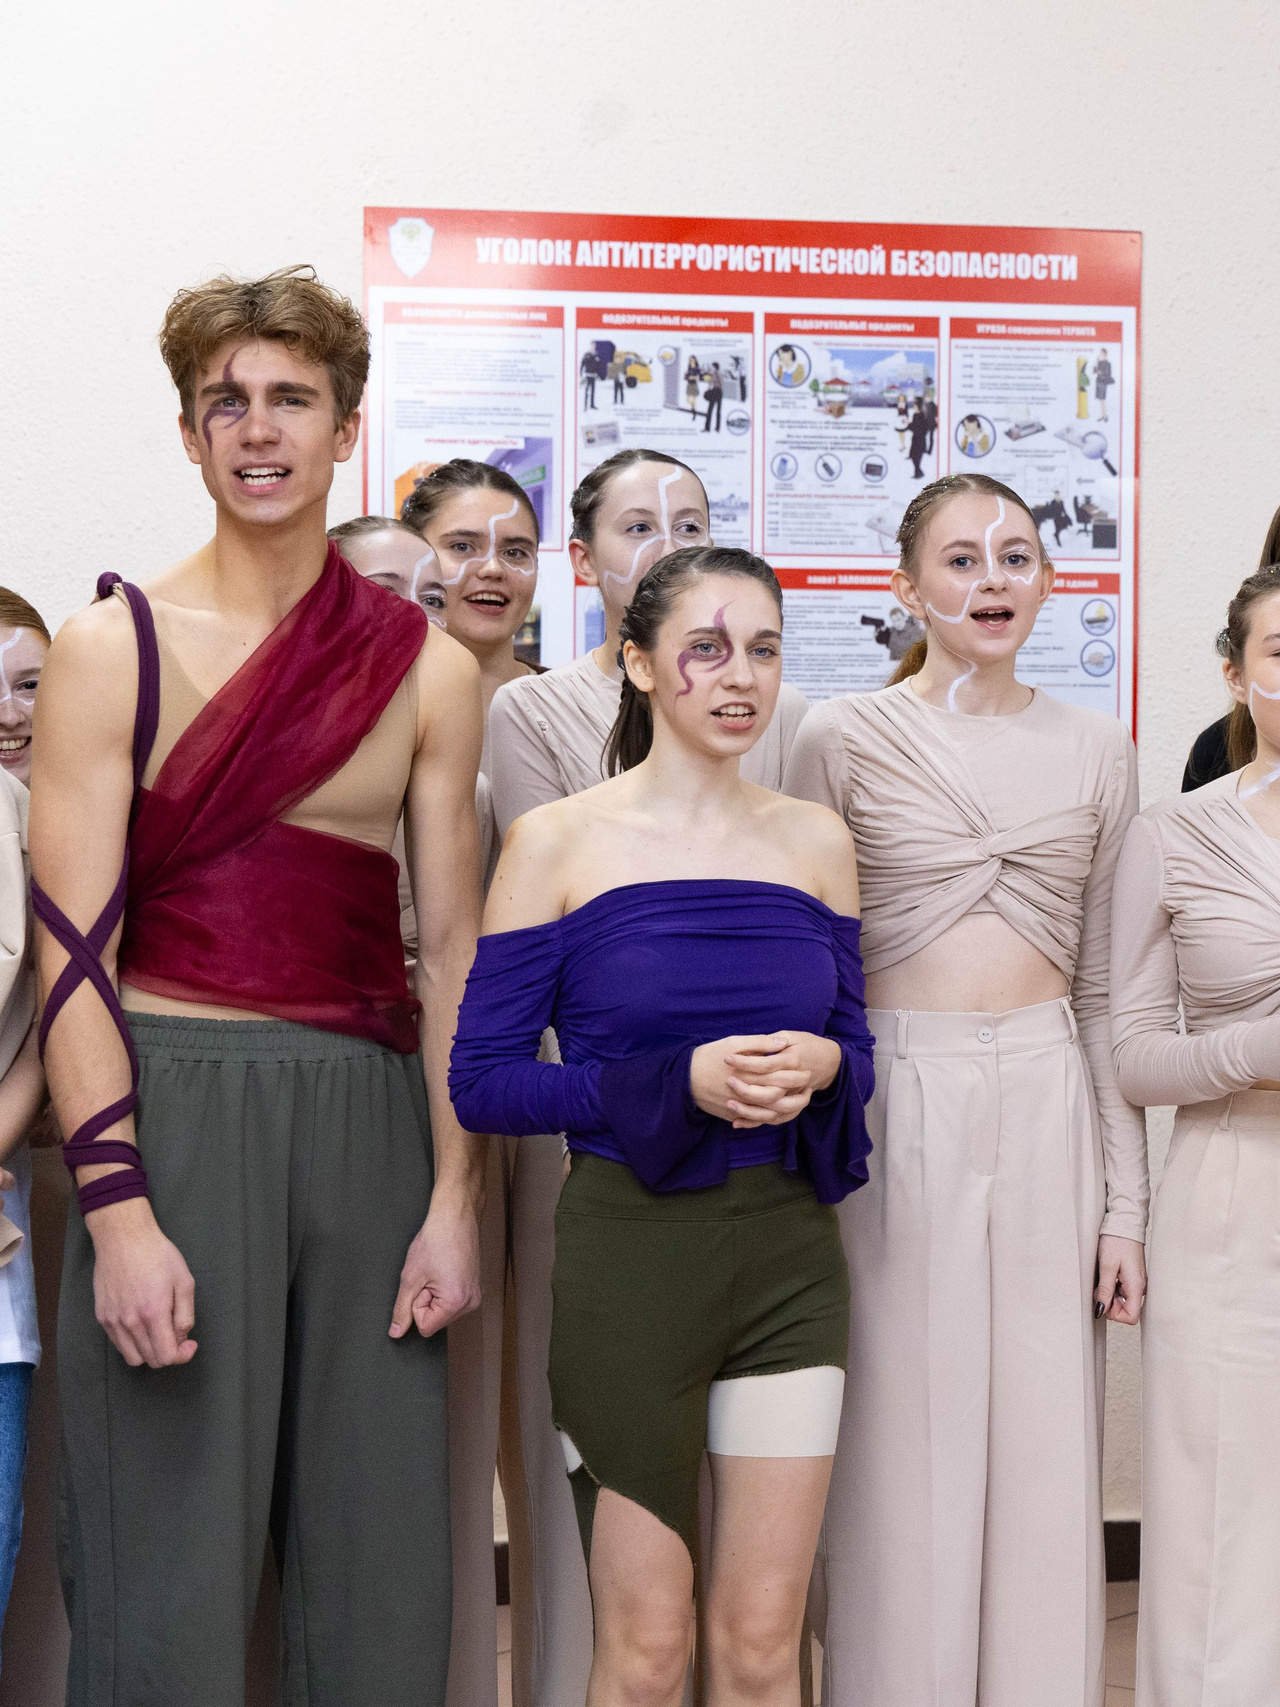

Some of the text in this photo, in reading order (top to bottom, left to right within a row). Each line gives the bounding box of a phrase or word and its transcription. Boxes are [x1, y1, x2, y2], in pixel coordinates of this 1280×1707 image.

[476, 237, 1078, 281] УГОЛОК АНТИТЕРРОРИСТИЧЕСКОЙ БЕЗОПАСНОСТИ
